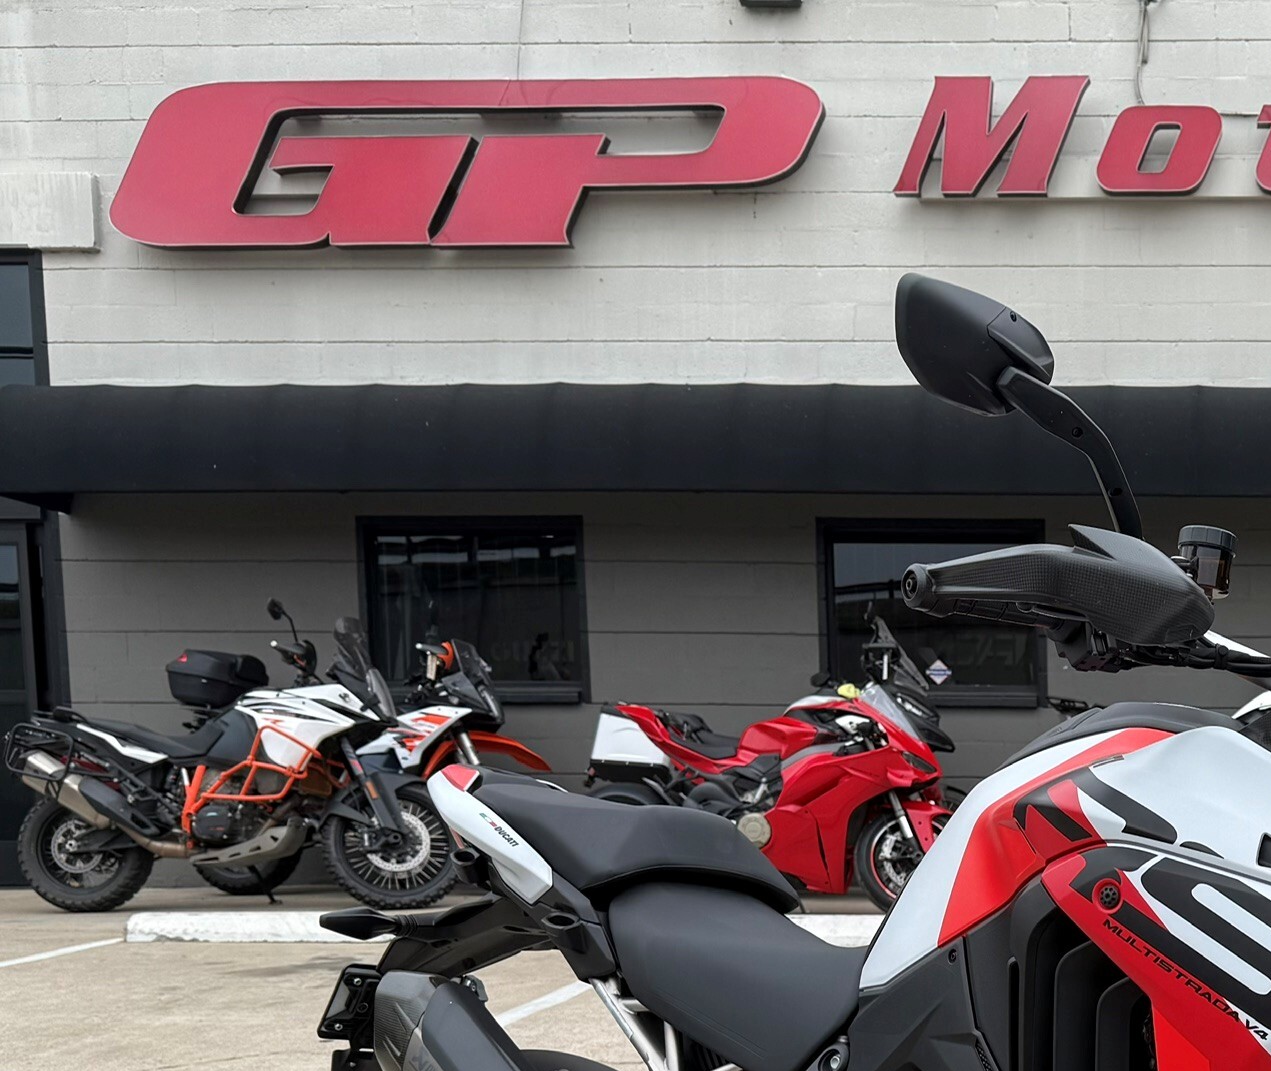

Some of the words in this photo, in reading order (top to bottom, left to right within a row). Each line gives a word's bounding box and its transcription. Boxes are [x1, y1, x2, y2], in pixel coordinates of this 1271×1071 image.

[109, 75, 825, 249] GP
[494, 826, 519, 847] DUCATI
[1103, 919, 1241, 1022] MULTISTRADA
[1245, 1019, 1269, 1041] V4
